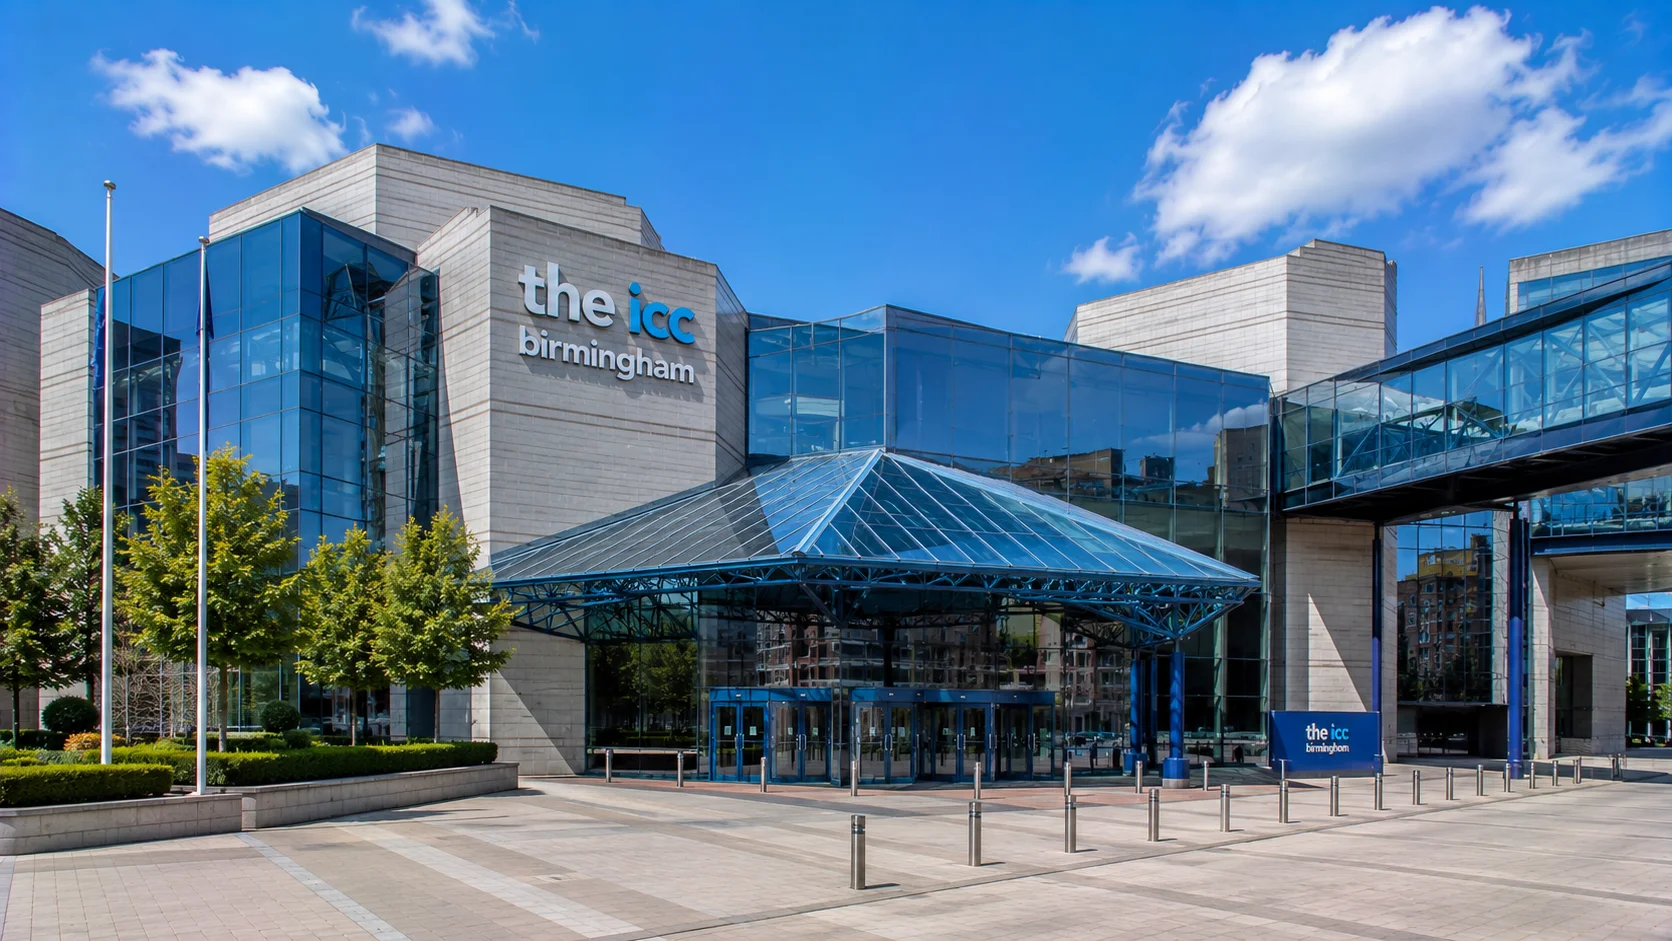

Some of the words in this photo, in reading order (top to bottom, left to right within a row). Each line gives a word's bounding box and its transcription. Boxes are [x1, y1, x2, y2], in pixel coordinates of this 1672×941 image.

[518, 261, 616, 328] the
[628, 281, 696, 345] icc
[518, 325, 695, 385] birmingham
[1305, 722, 1329, 740] the
[1330, 722, 1350, 740] icc
[1305, 741, 1351, 756] birmingham
